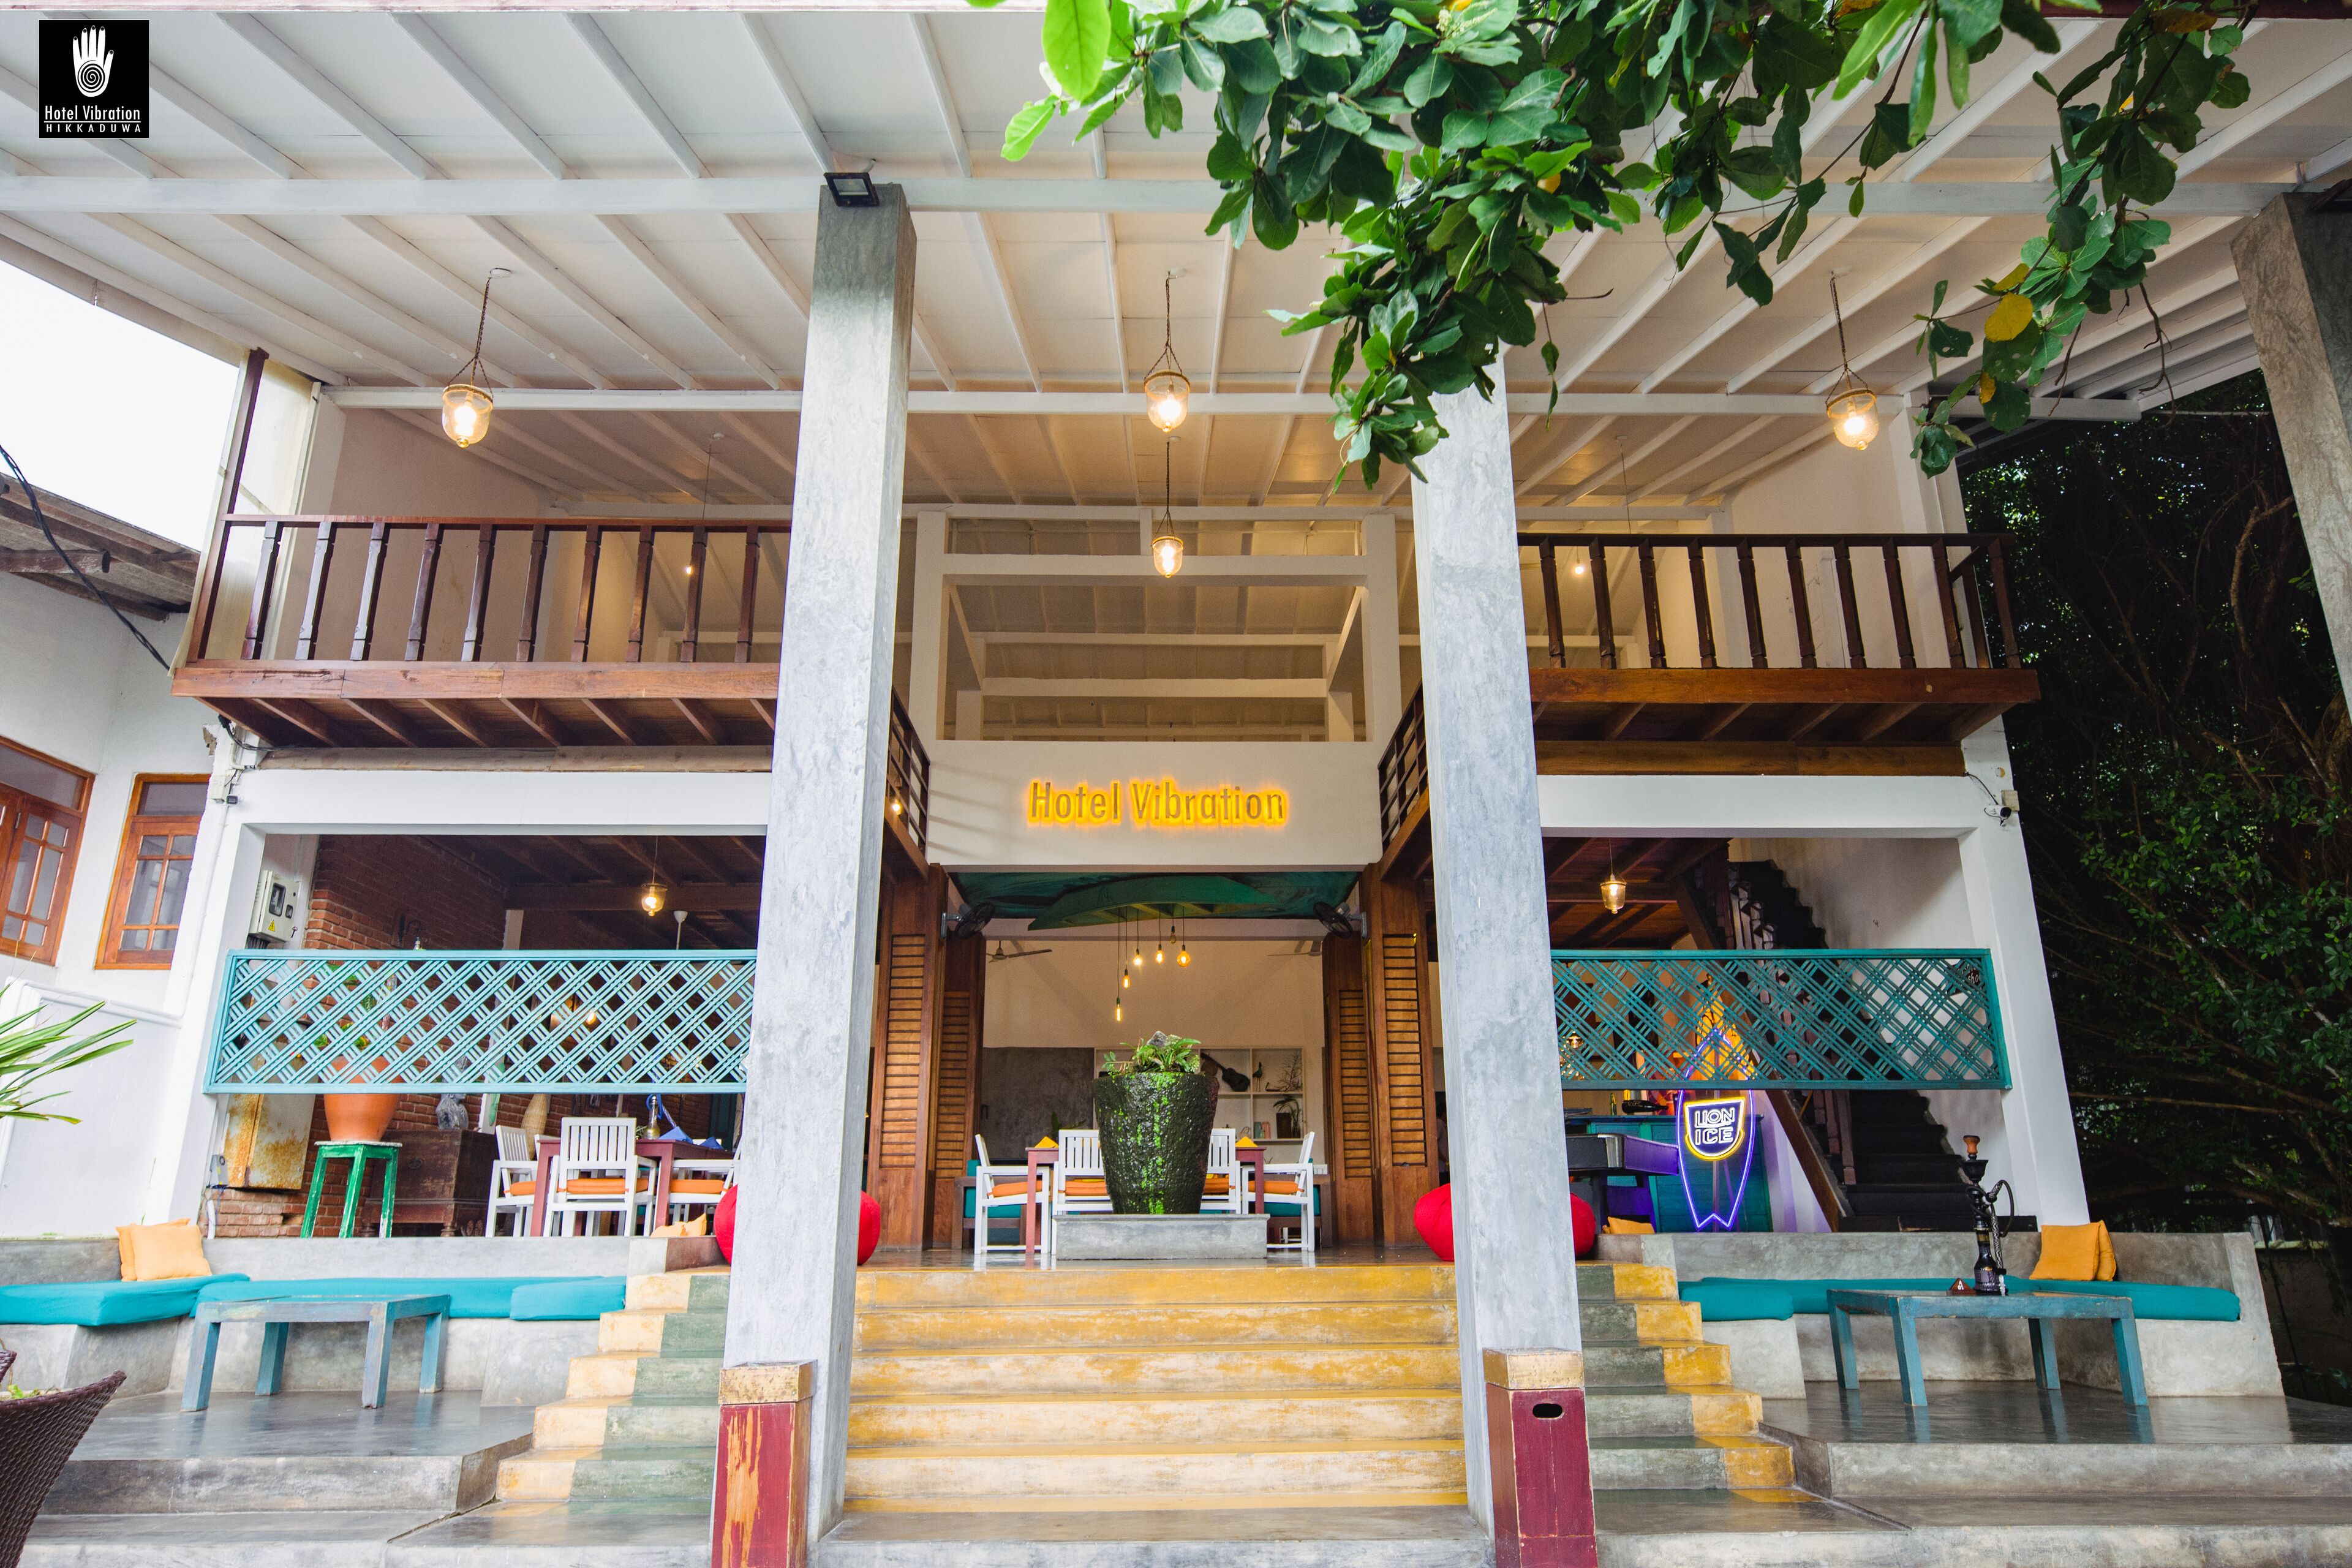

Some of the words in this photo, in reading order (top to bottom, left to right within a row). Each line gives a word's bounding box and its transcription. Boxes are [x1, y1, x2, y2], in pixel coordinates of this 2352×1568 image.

[1030, 780, 1120, 821] Hotel
[1131, 780, 1286, 821] Vibration
[1694, 1107, 1735, 1128] LION
[1695, 1126, 1733, 1145] ICE
